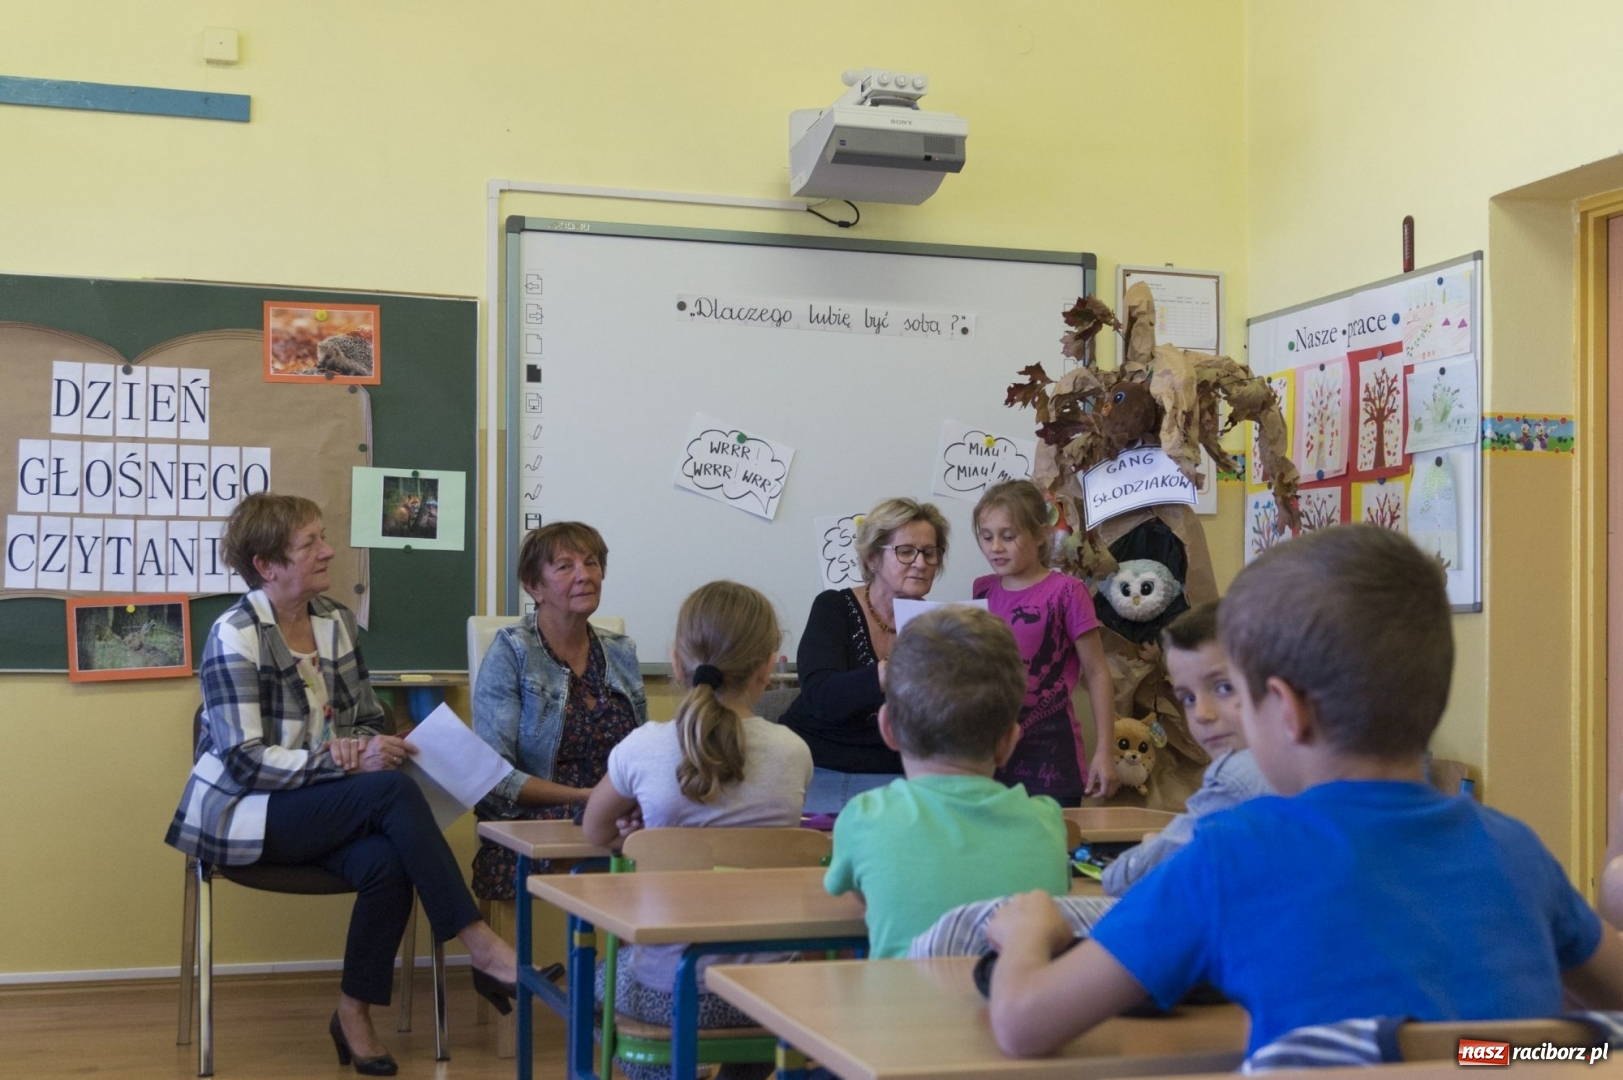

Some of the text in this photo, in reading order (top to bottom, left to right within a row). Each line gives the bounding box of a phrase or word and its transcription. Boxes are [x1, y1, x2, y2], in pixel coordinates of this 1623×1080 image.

[890, 118, 913, 126] SONY
[809, 304, 851, 328] lubię
[865, 308, 889, 334] być
[904, 313, 941, 335] sobą
[1295, 313, 1387, 352] Nasze prace
[52, 378, 210, 423] DZIEŃ
[19, 453, 269, 500] GŁOŚNEGO
[1106, 452, 1154, 474] GANG
[1093, 467, 1190, 508] SŁODZIAKÓW
[8, 533, 243, 576] CZYTANI
